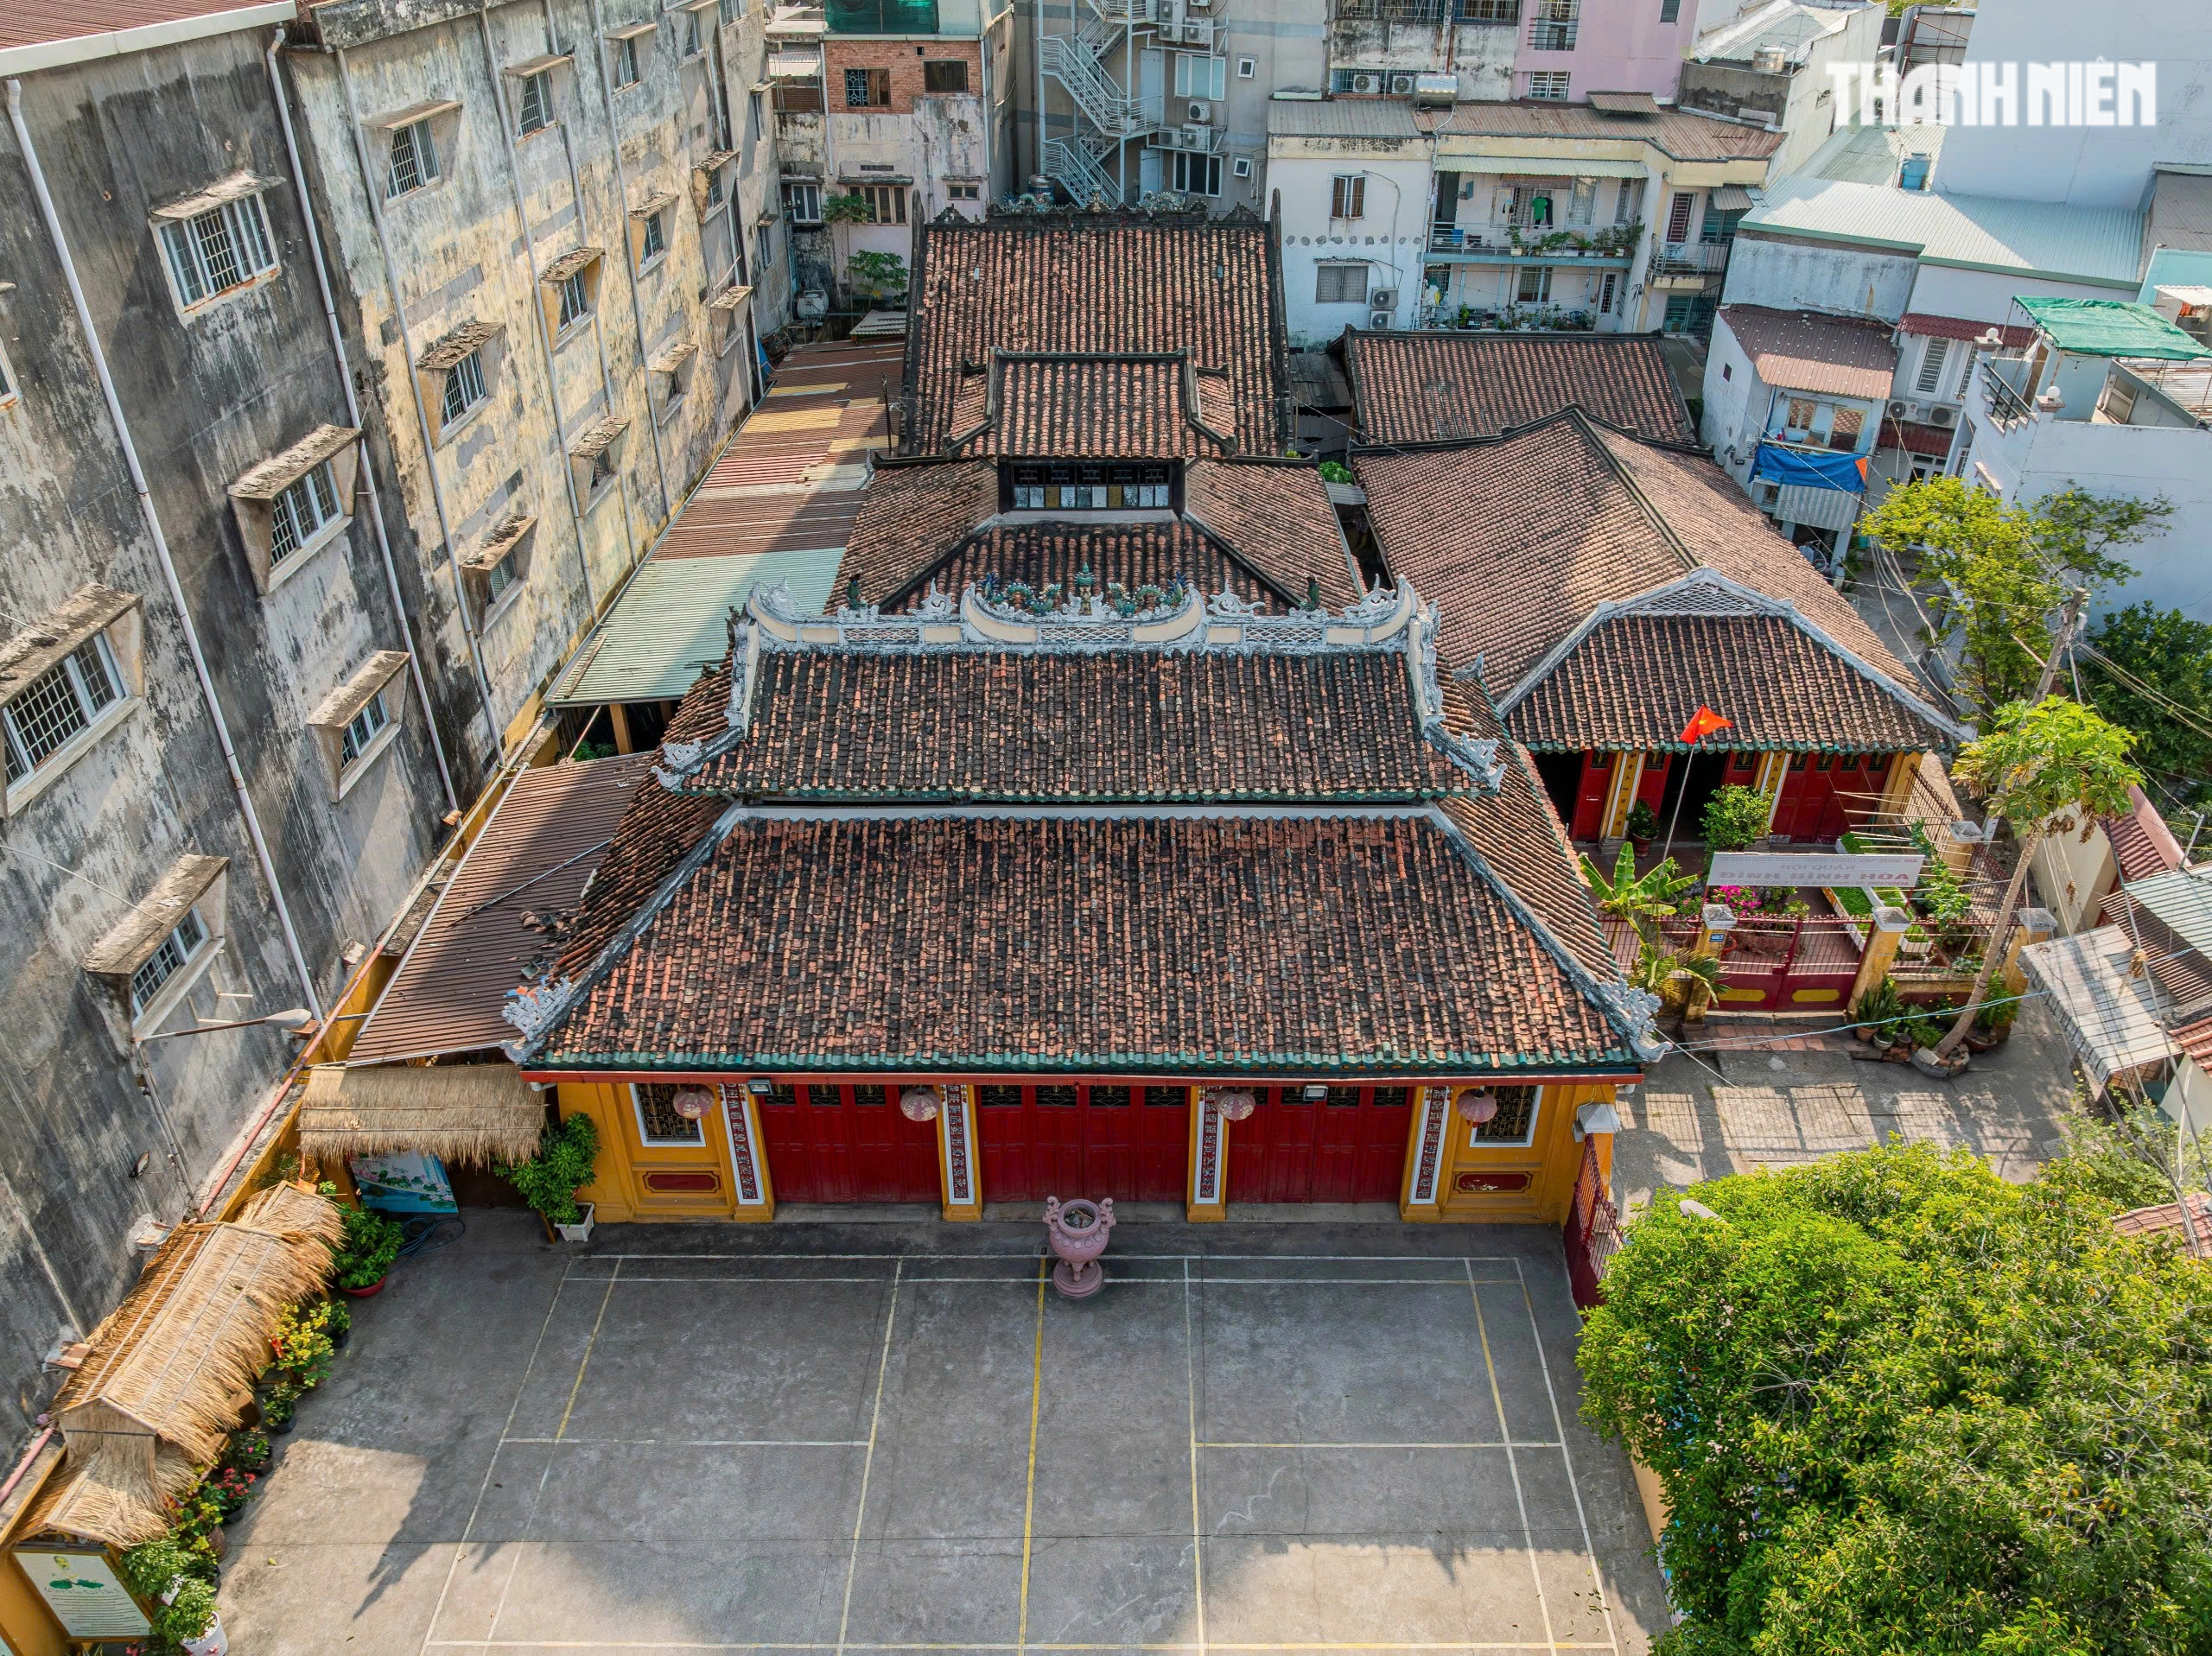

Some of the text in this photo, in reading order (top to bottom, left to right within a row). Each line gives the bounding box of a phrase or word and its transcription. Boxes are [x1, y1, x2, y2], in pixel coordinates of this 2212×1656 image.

[1719, 871, 1910, 880] ĐÌNH BÌNH HÒA
